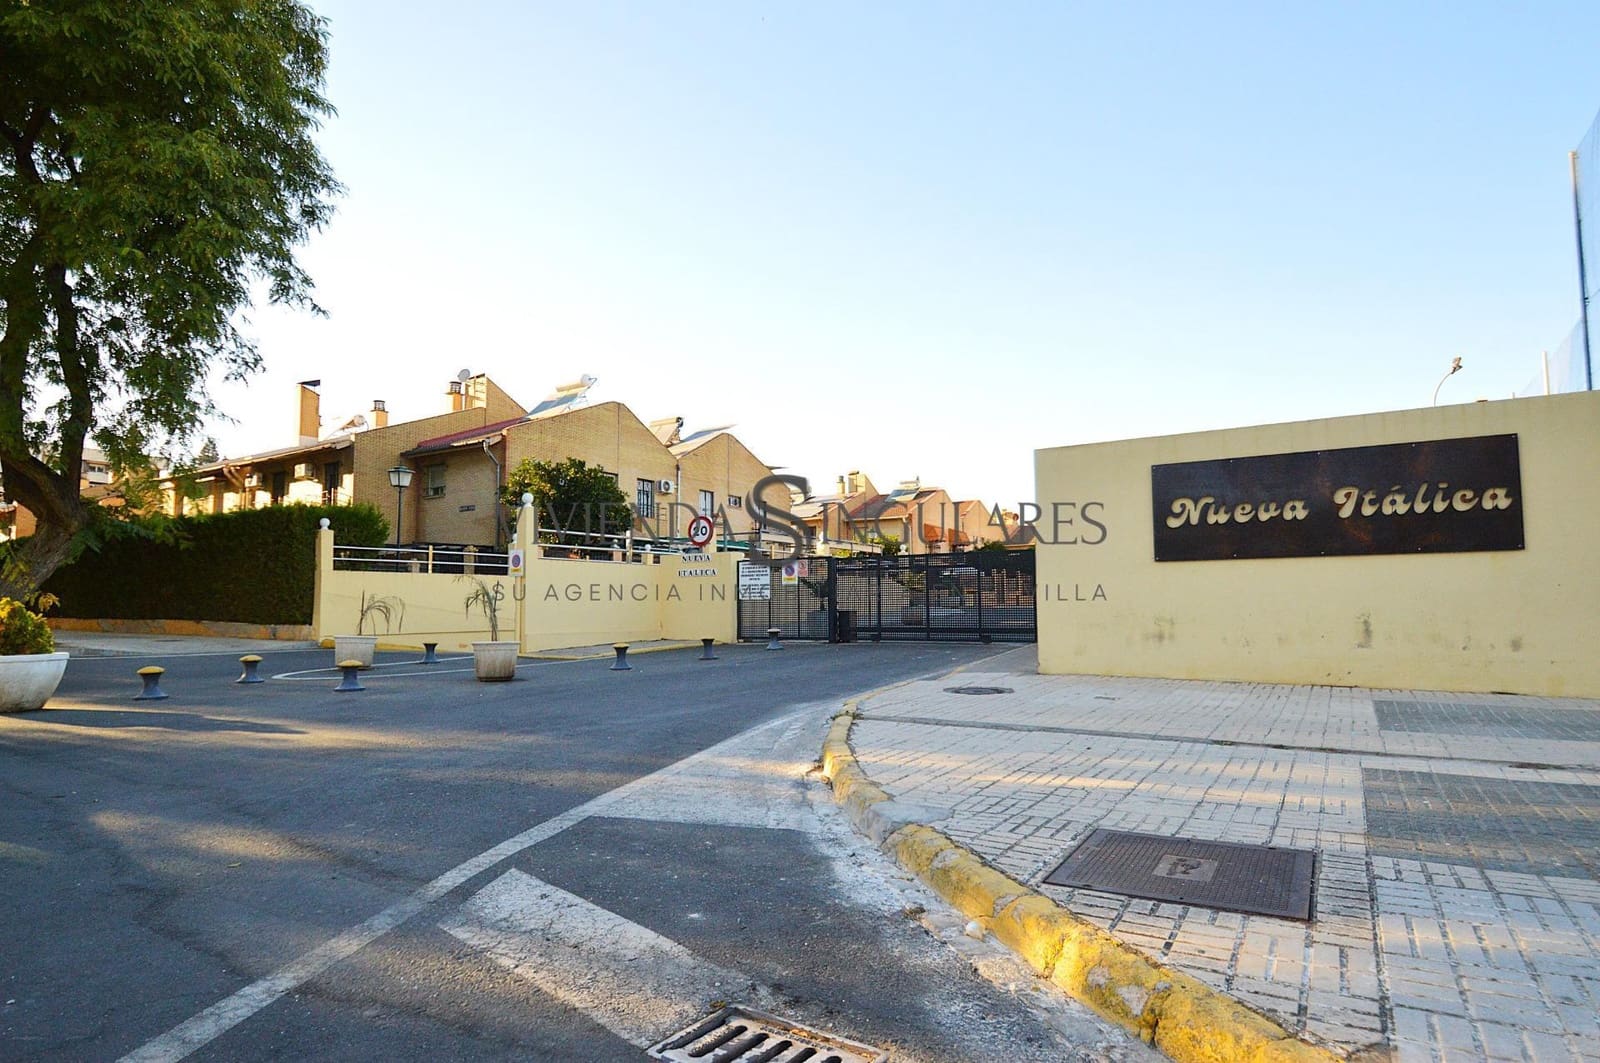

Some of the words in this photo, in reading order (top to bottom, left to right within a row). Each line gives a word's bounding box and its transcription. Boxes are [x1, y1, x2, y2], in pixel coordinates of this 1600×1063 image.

[1165, 496, 1310, 529] Nueva
[1333, 481, 1514, 519] Itálica
[693, 525, 708, 537] 20
[682, 554, 711, 563] NUEVA
